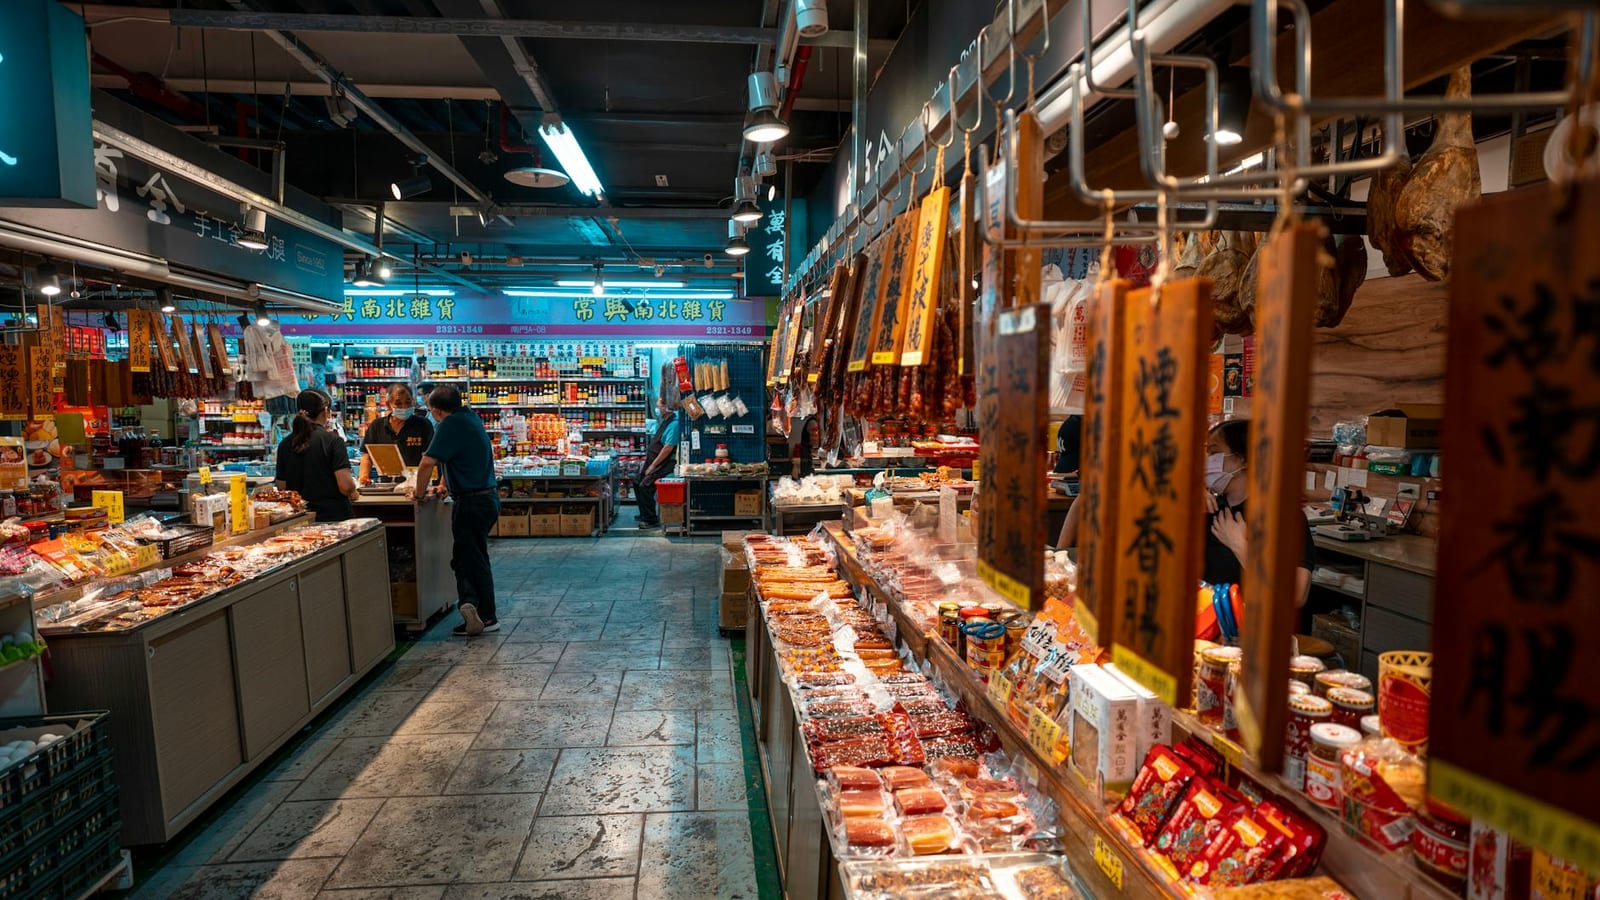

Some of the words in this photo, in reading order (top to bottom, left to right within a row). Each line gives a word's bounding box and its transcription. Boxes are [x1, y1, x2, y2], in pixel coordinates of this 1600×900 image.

[764, 209, 786, 284] 萬有全
[573, 298, 726, 321] 常興南北雜貨
[436, 325, 483, 334] 2321-1349
[706, 326, 752, 335] 2321-1349
[1124, 346, 1180, 651] 煙燻香腸
[1116, 709, 1127, 741] 萬有全
